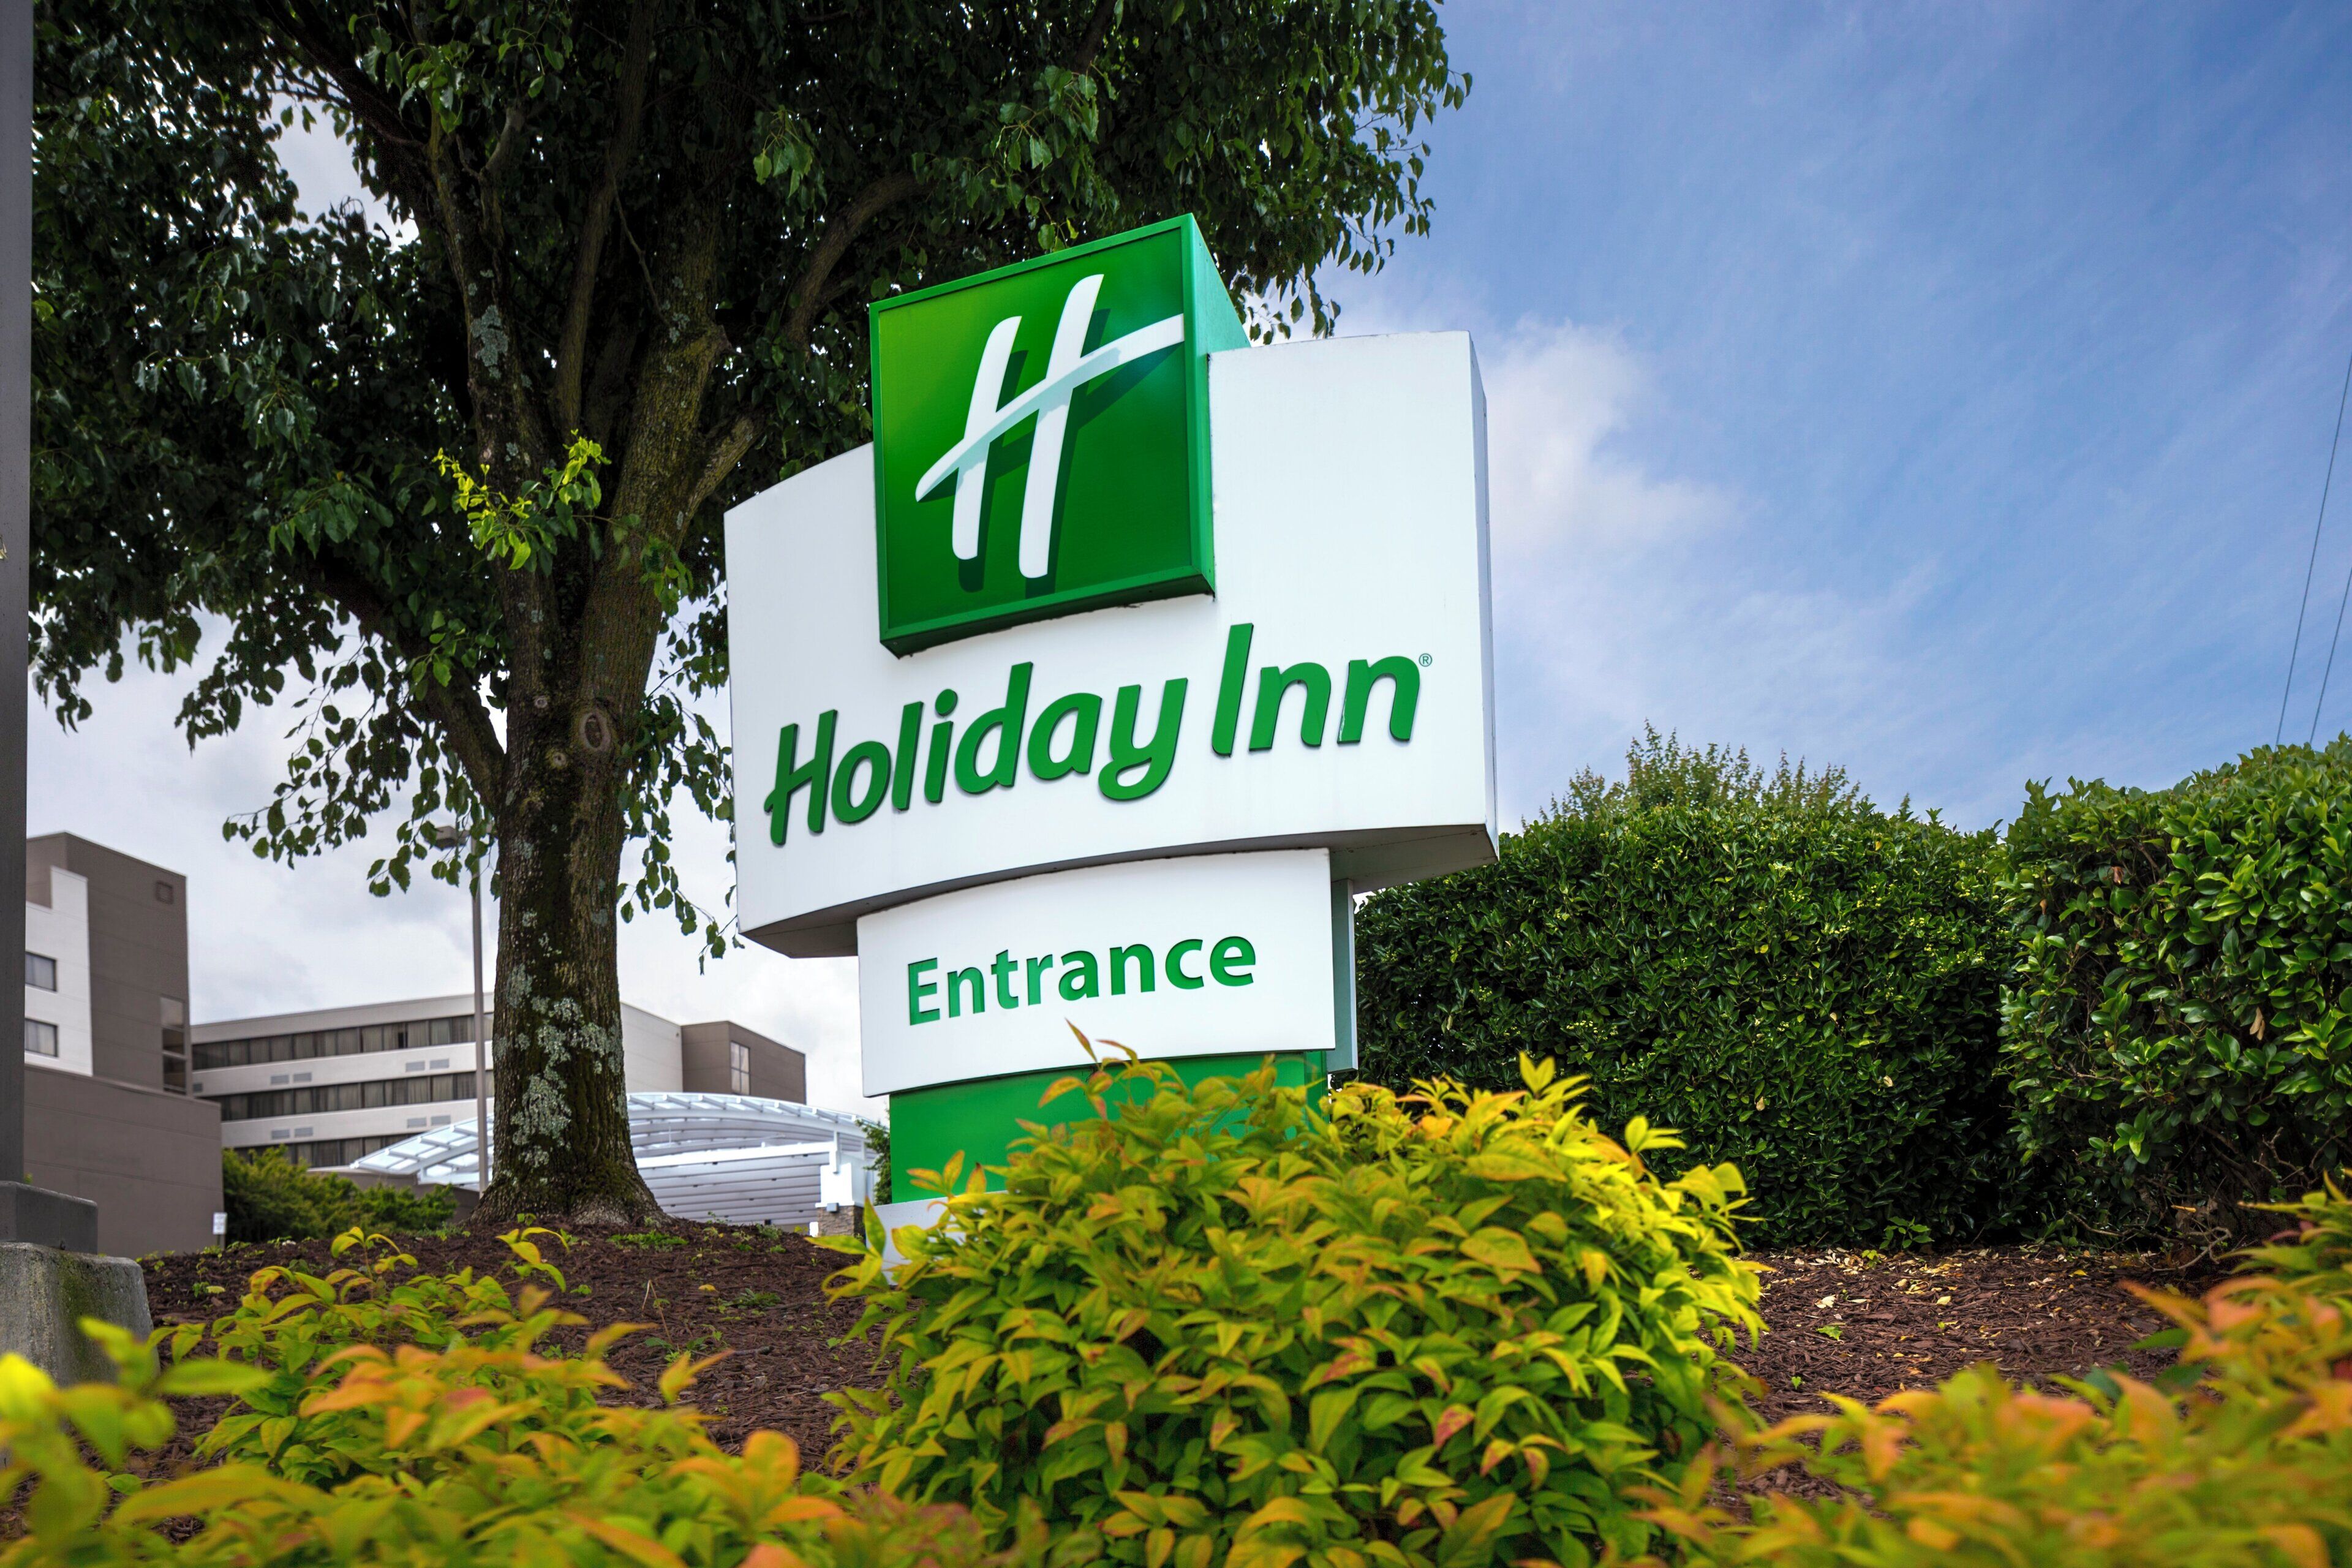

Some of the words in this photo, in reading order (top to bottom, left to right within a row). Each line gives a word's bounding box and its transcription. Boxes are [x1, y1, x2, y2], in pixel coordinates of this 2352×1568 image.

[915, 274, 1185, 578] H
[764, 662, 1188, 846] Holiday
[908, 936, 1256, 1026] Entrance
